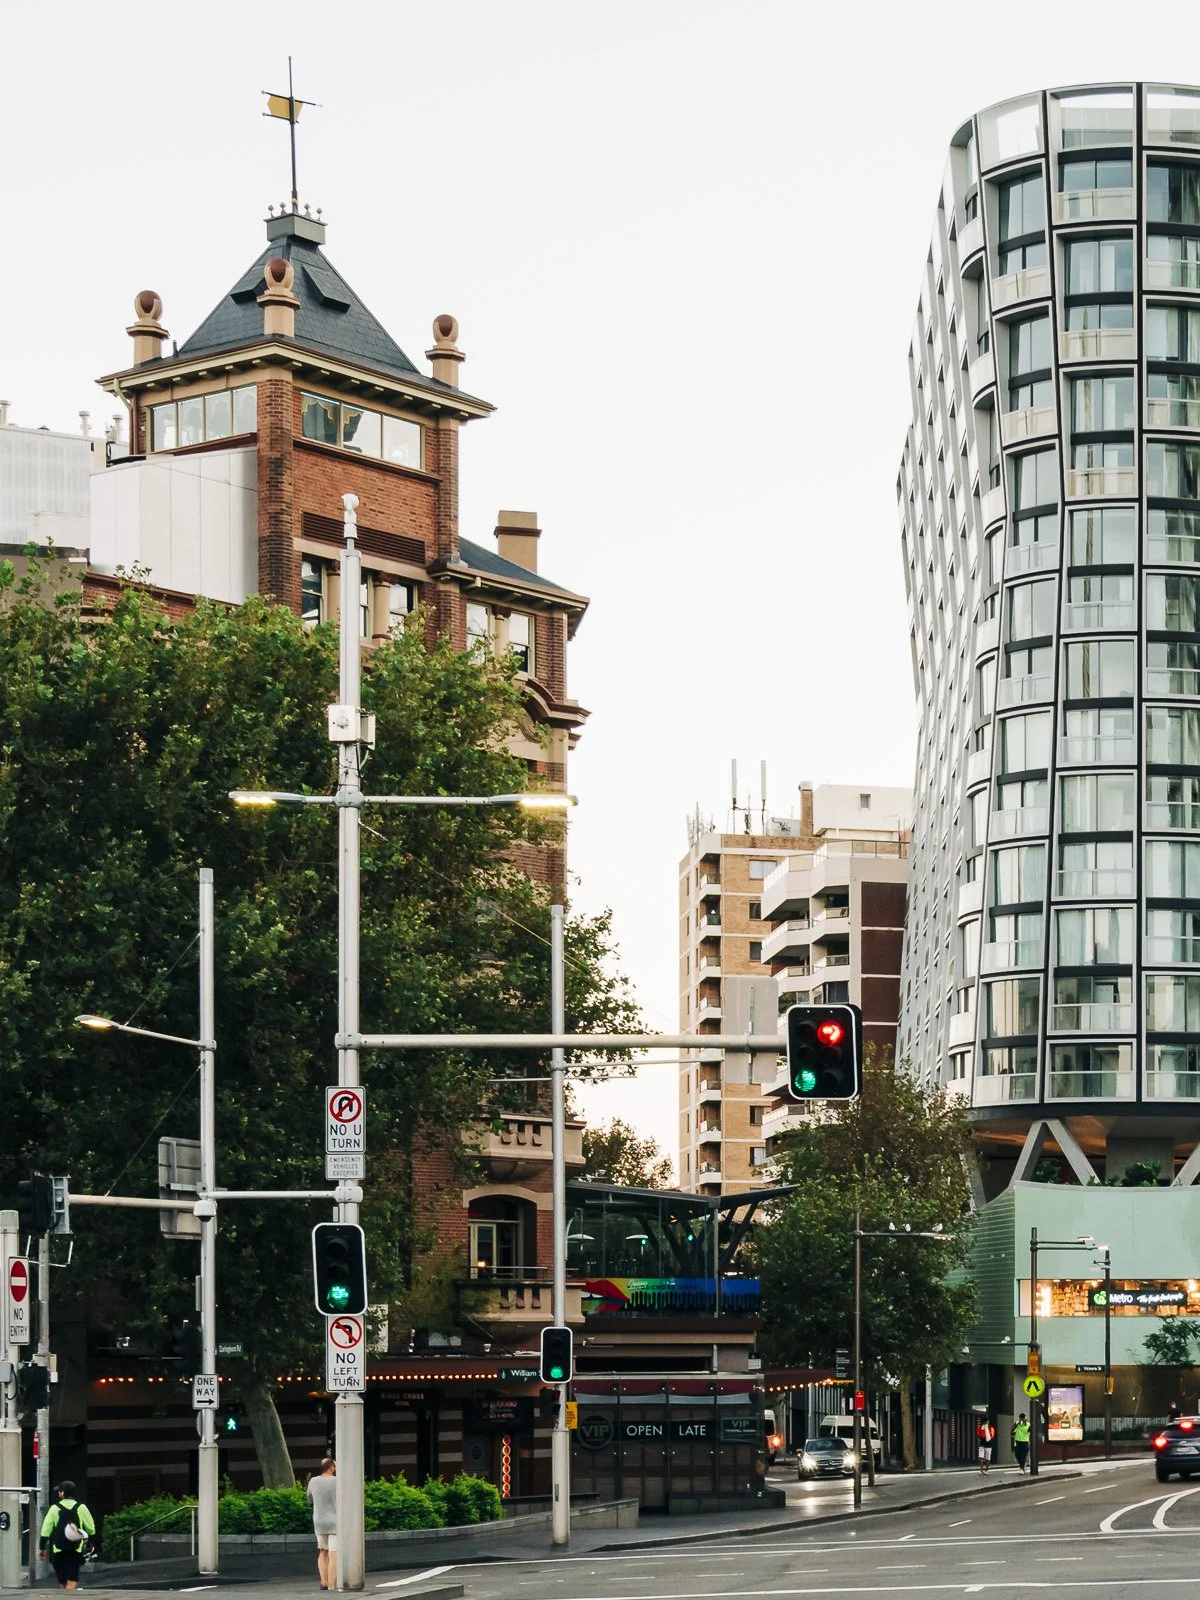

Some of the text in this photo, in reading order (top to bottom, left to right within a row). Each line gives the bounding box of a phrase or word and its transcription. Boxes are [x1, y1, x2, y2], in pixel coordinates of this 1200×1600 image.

[330, 1124, 362, 1135] NO U
[331, 1138, 361, 1148] TURN
[1109, 1293, 1133, 1304] Metro
[13, 1307, 24, 1321] NO
[10, 1325, 28, 1337] ENTRY
[336, 1352, 356, 1364] NO
[333, 1367, 358, 1376] LEFT
[511, 1369, 537, 1377] William
[197, 1377, 215, 1386] ONE
[332, 1378, 360, 1387] TURN
[196, 1388, 216, 1396] WAY
[732, 1420, 749, 1428] VIP
[582, 1424, 610, 1437] VIP
[626, 1424, 706, 1436] OPEN LATE
